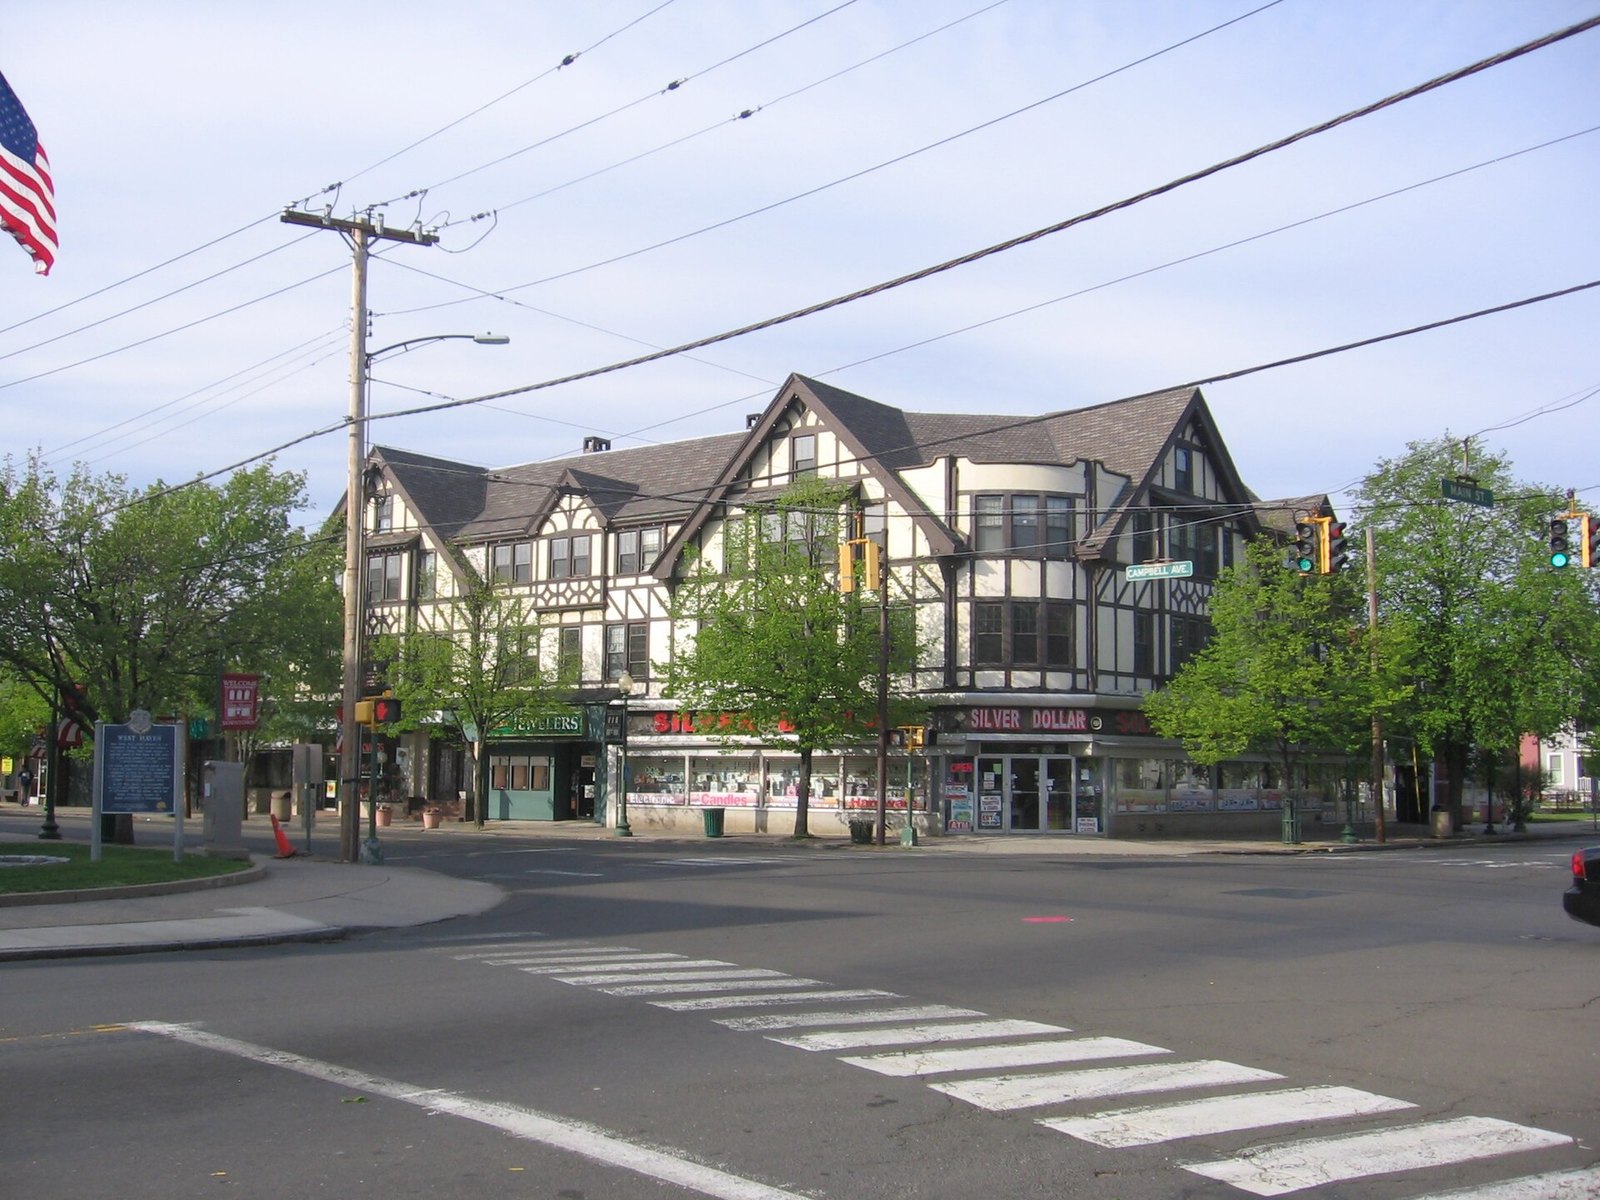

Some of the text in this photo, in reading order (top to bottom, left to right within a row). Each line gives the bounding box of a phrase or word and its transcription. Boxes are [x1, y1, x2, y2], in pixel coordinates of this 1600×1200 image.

[1450, 484, 1471, 500] MAIN
[1128, 565, 1169, 578] CAMPBELL
[971, 708, 1087, 730] SILVER DOLLAR
[951, 762, 974, 773] OPEN
[701, 793, 748, 806] Candles
[850, 798, 919, 809] Harware
[949, 821, 971, 830] ATM
